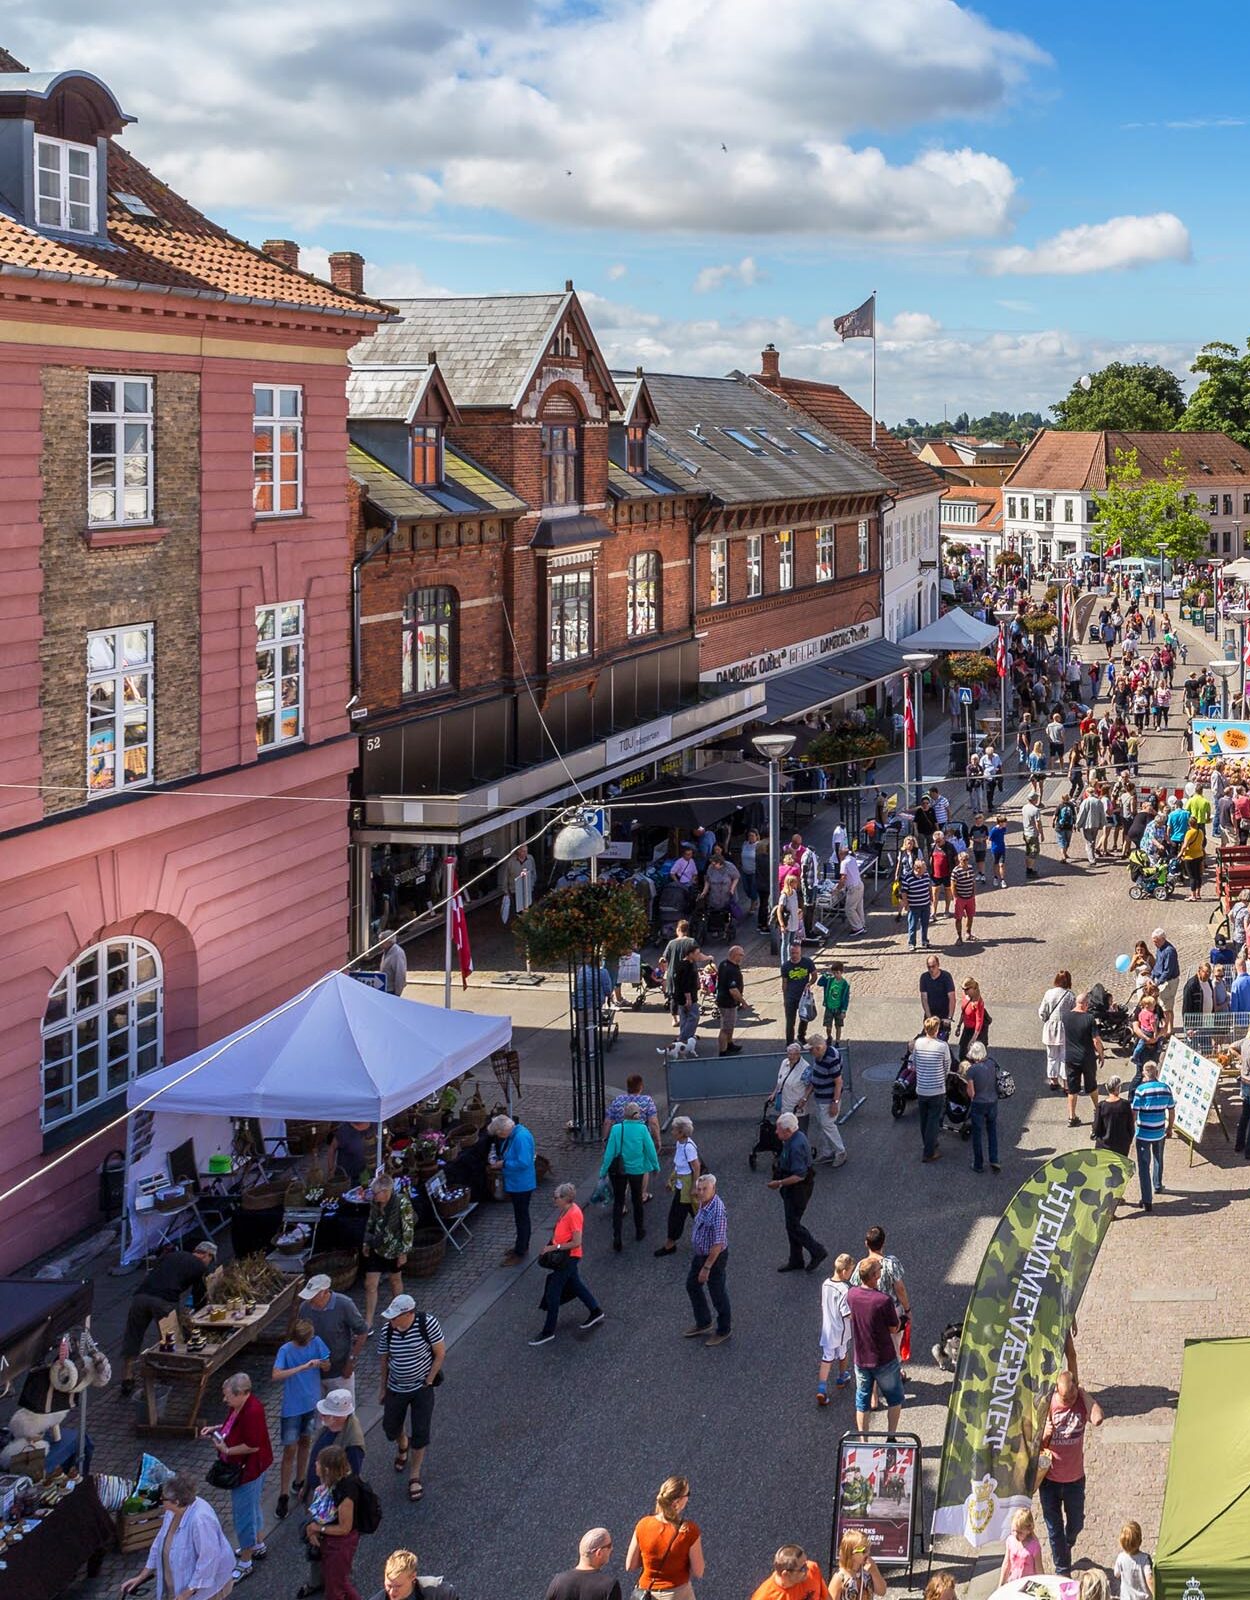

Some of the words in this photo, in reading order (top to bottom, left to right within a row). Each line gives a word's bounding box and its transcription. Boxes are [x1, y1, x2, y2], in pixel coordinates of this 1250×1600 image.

[716, 659, 757, 683] DAMBORG
[367, 737, 381, 751] 52
[982, 1181, 1075, 1450] HJEMMEVÆRNET
